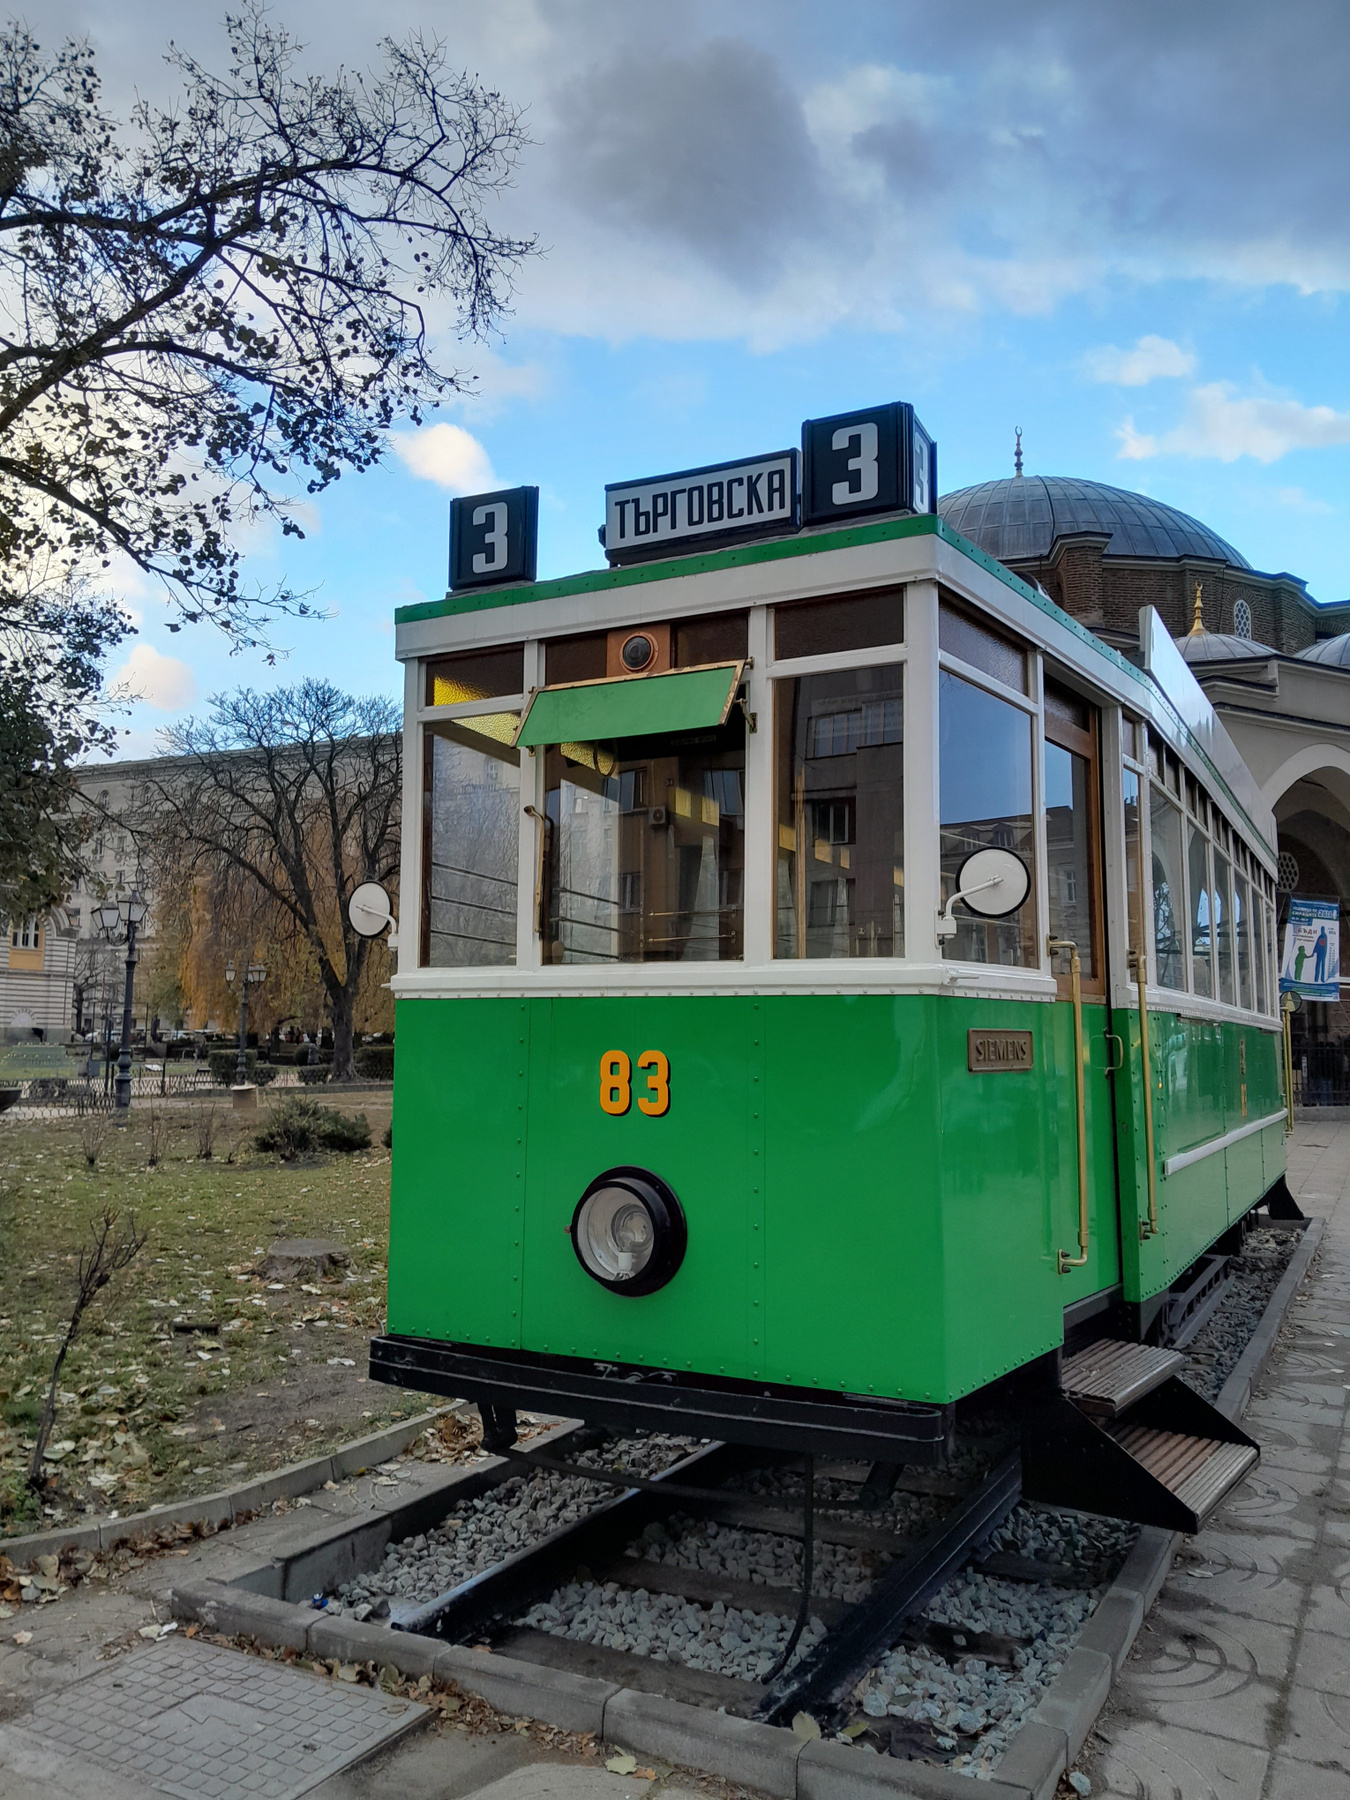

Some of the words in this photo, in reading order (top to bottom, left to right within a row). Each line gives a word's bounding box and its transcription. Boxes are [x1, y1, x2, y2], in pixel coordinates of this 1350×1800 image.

[831, 421, 879, 506] 3
[914, 431, 929, 513] 3
[472, 501, 508, 574] 3
[614, 468, 785, 540] ТЪРГОВСКА
[599, 1049, 671, 1117] 83
[975, 1039, 1027, 1061] SIEMENS
